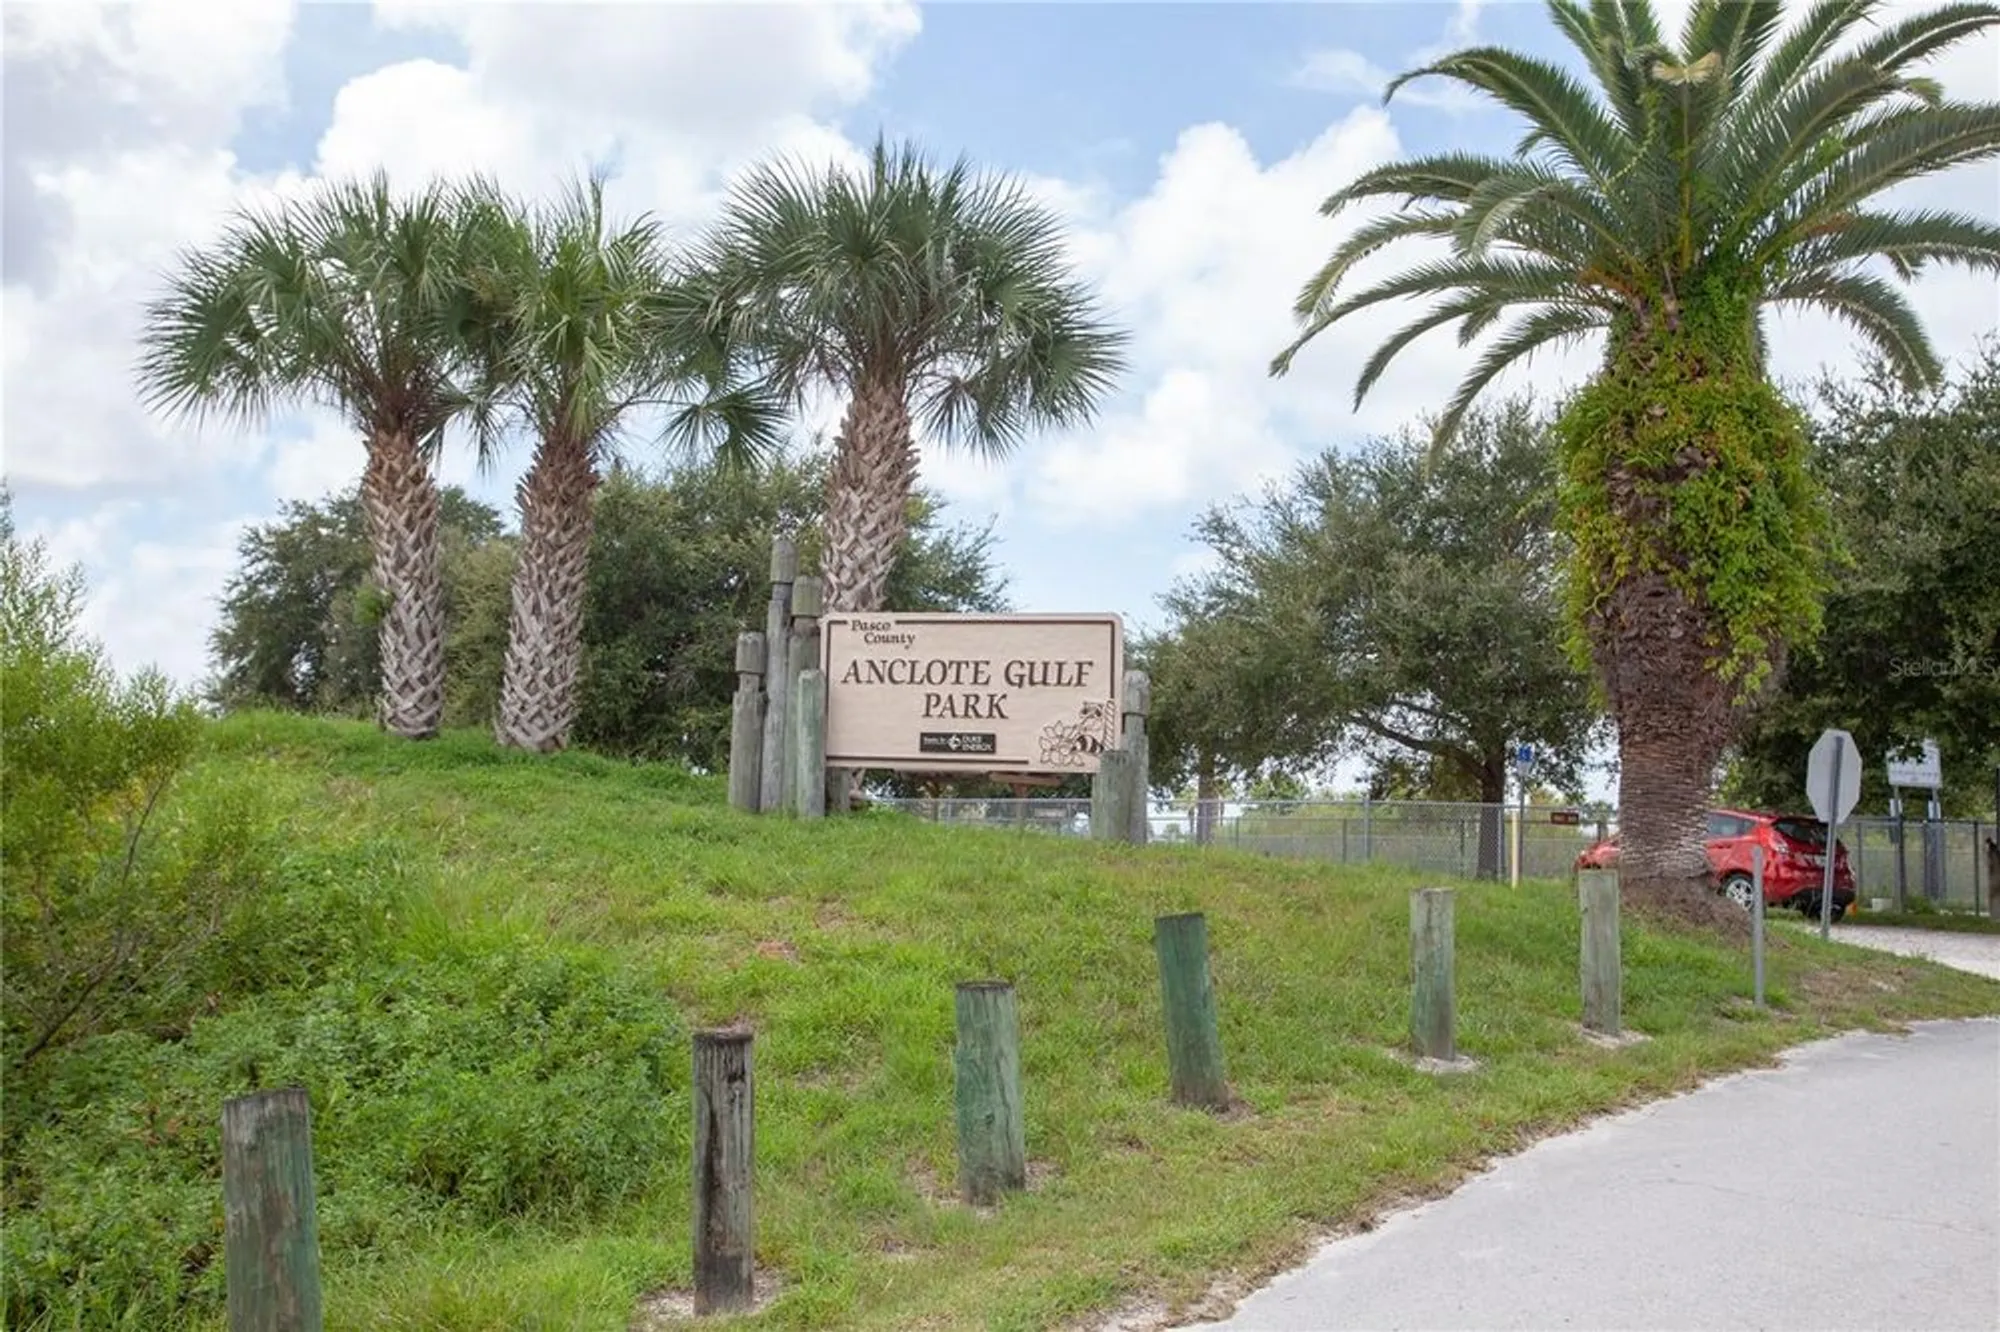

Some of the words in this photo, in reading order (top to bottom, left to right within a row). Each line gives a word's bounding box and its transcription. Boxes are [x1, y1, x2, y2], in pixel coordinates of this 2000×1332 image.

[851, 619, 892, 631] Pasco
[864, 632, 915, 649] County
[842, 660, 991, 686] ANCLOTE
[1004, 660, 1093, 688] GULF
[922, 693, 1008, 719] PARK
